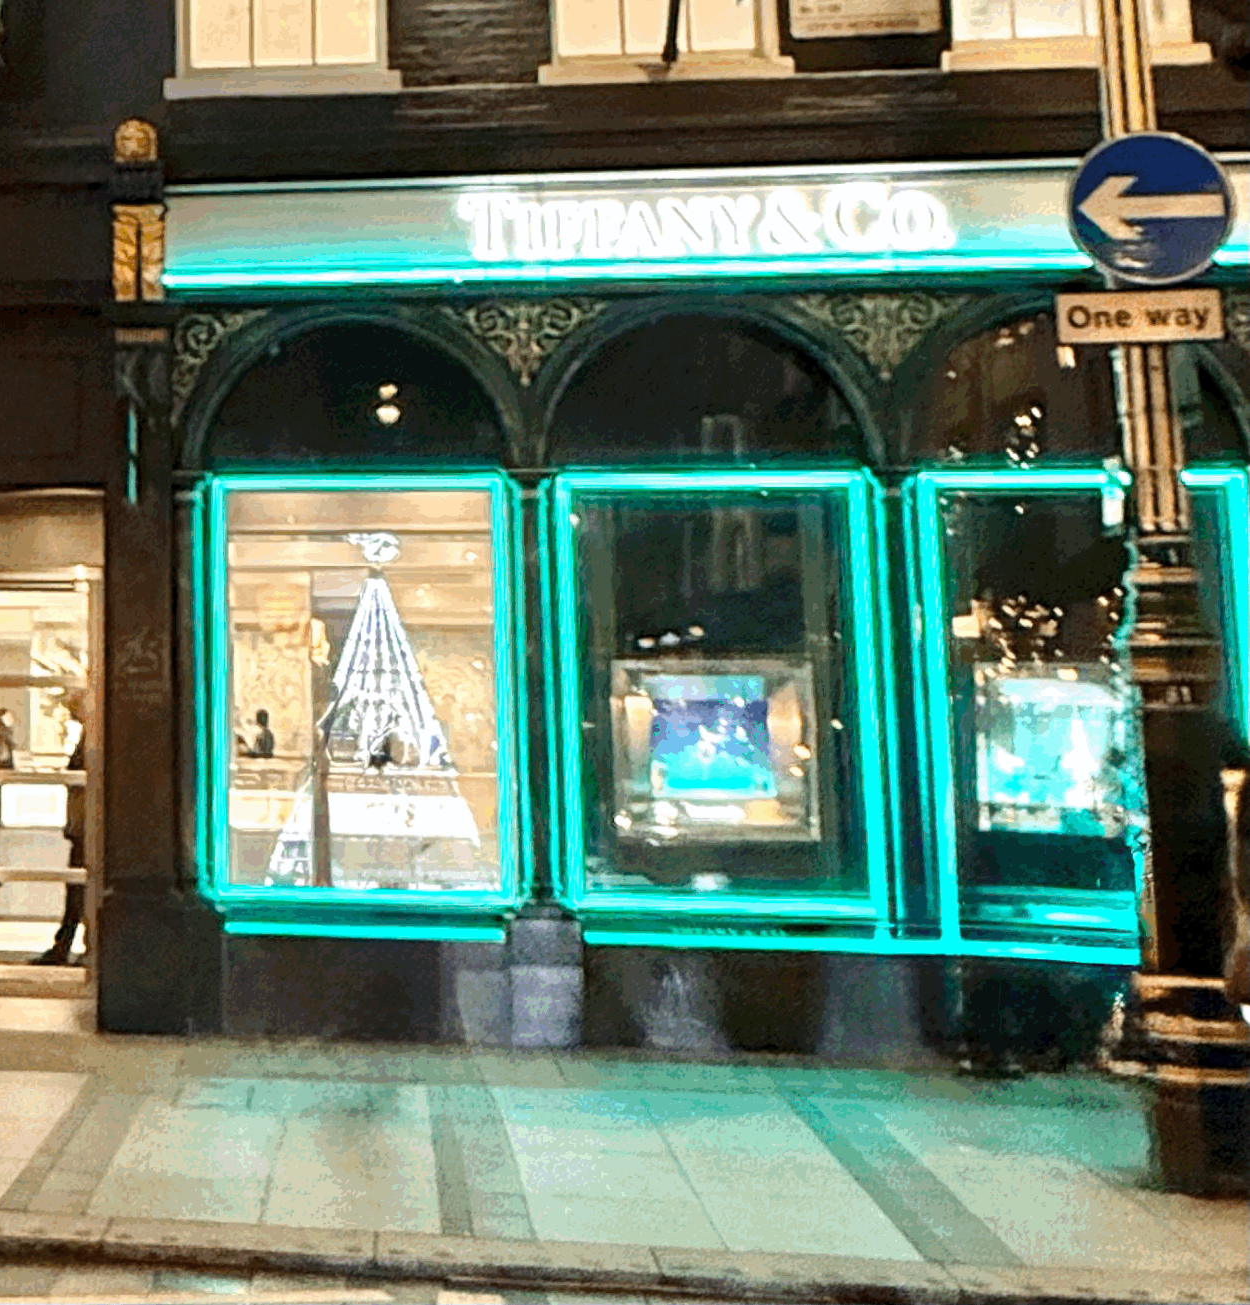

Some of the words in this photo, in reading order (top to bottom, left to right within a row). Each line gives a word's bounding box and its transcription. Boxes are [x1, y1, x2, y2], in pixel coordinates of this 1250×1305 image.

[457, 195, 762, 261] TIFFANY
[1067, 305, 1132, 329] One
[1144, 306, 1210, 331] way
